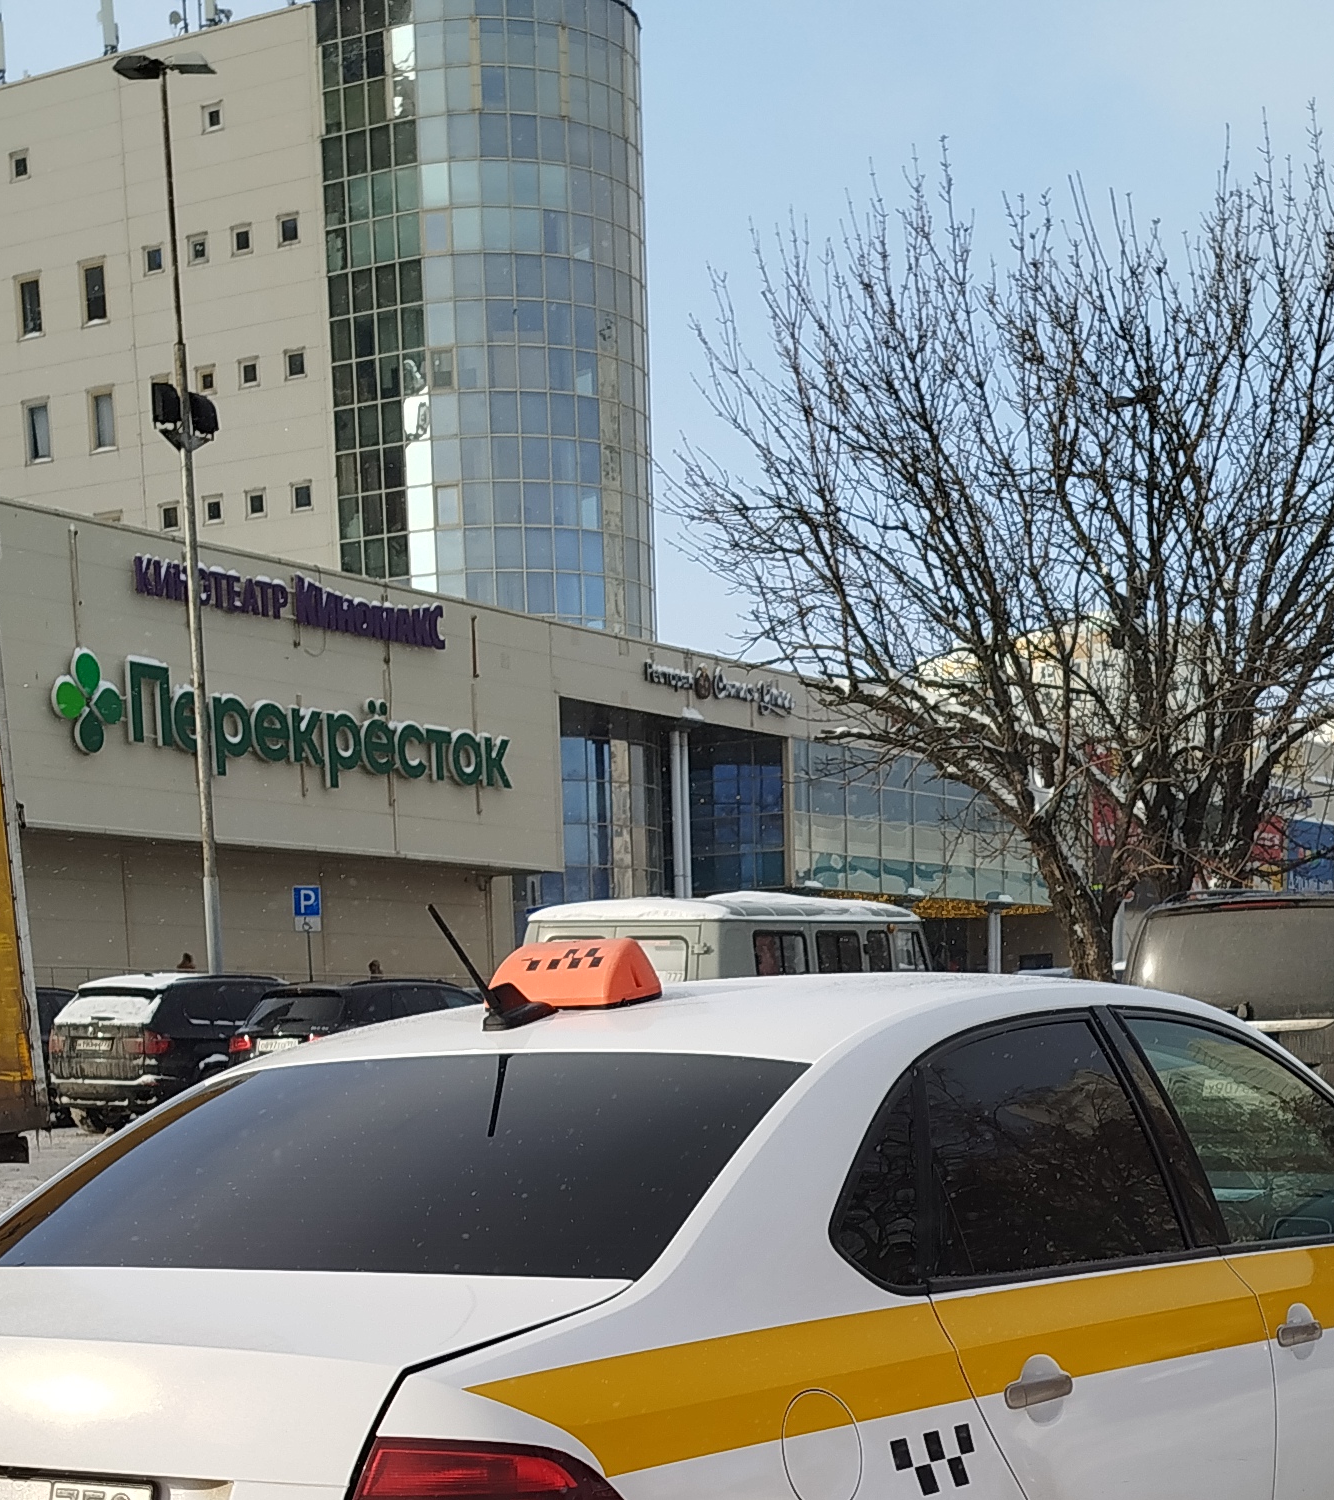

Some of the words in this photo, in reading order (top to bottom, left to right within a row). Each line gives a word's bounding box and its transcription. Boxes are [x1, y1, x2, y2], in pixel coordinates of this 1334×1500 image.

[134, 555, 288, 619] КИНОТЕАТР
[295, 572, 446, 650] КИНОМАКС
[125, 655, 513, 790] Перекрёсток
[300, 890, 315, 912] P
